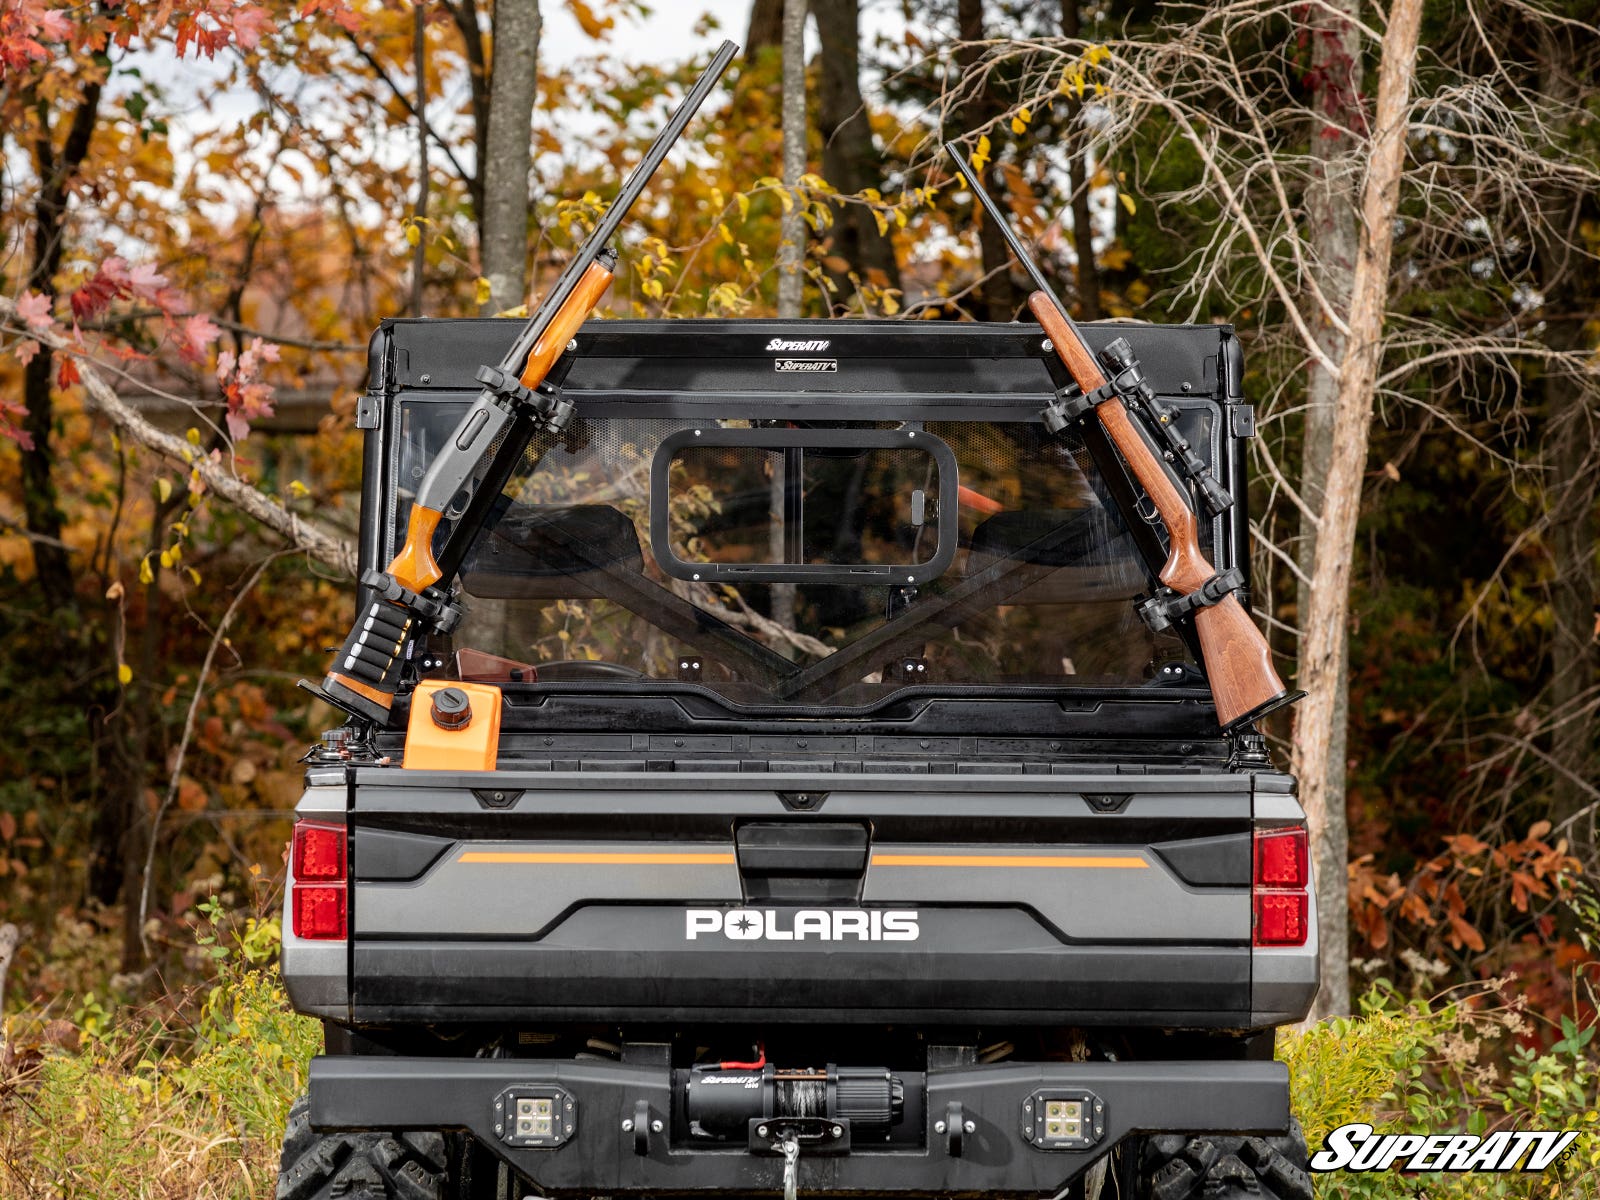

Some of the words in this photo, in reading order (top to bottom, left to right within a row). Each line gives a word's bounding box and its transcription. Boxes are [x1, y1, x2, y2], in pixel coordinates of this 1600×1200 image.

[766, 338, 830, 351] SUPERATV
[781, 361, 831, 371] SUPERATV
[686, 909, 920, 941] POLARIS
